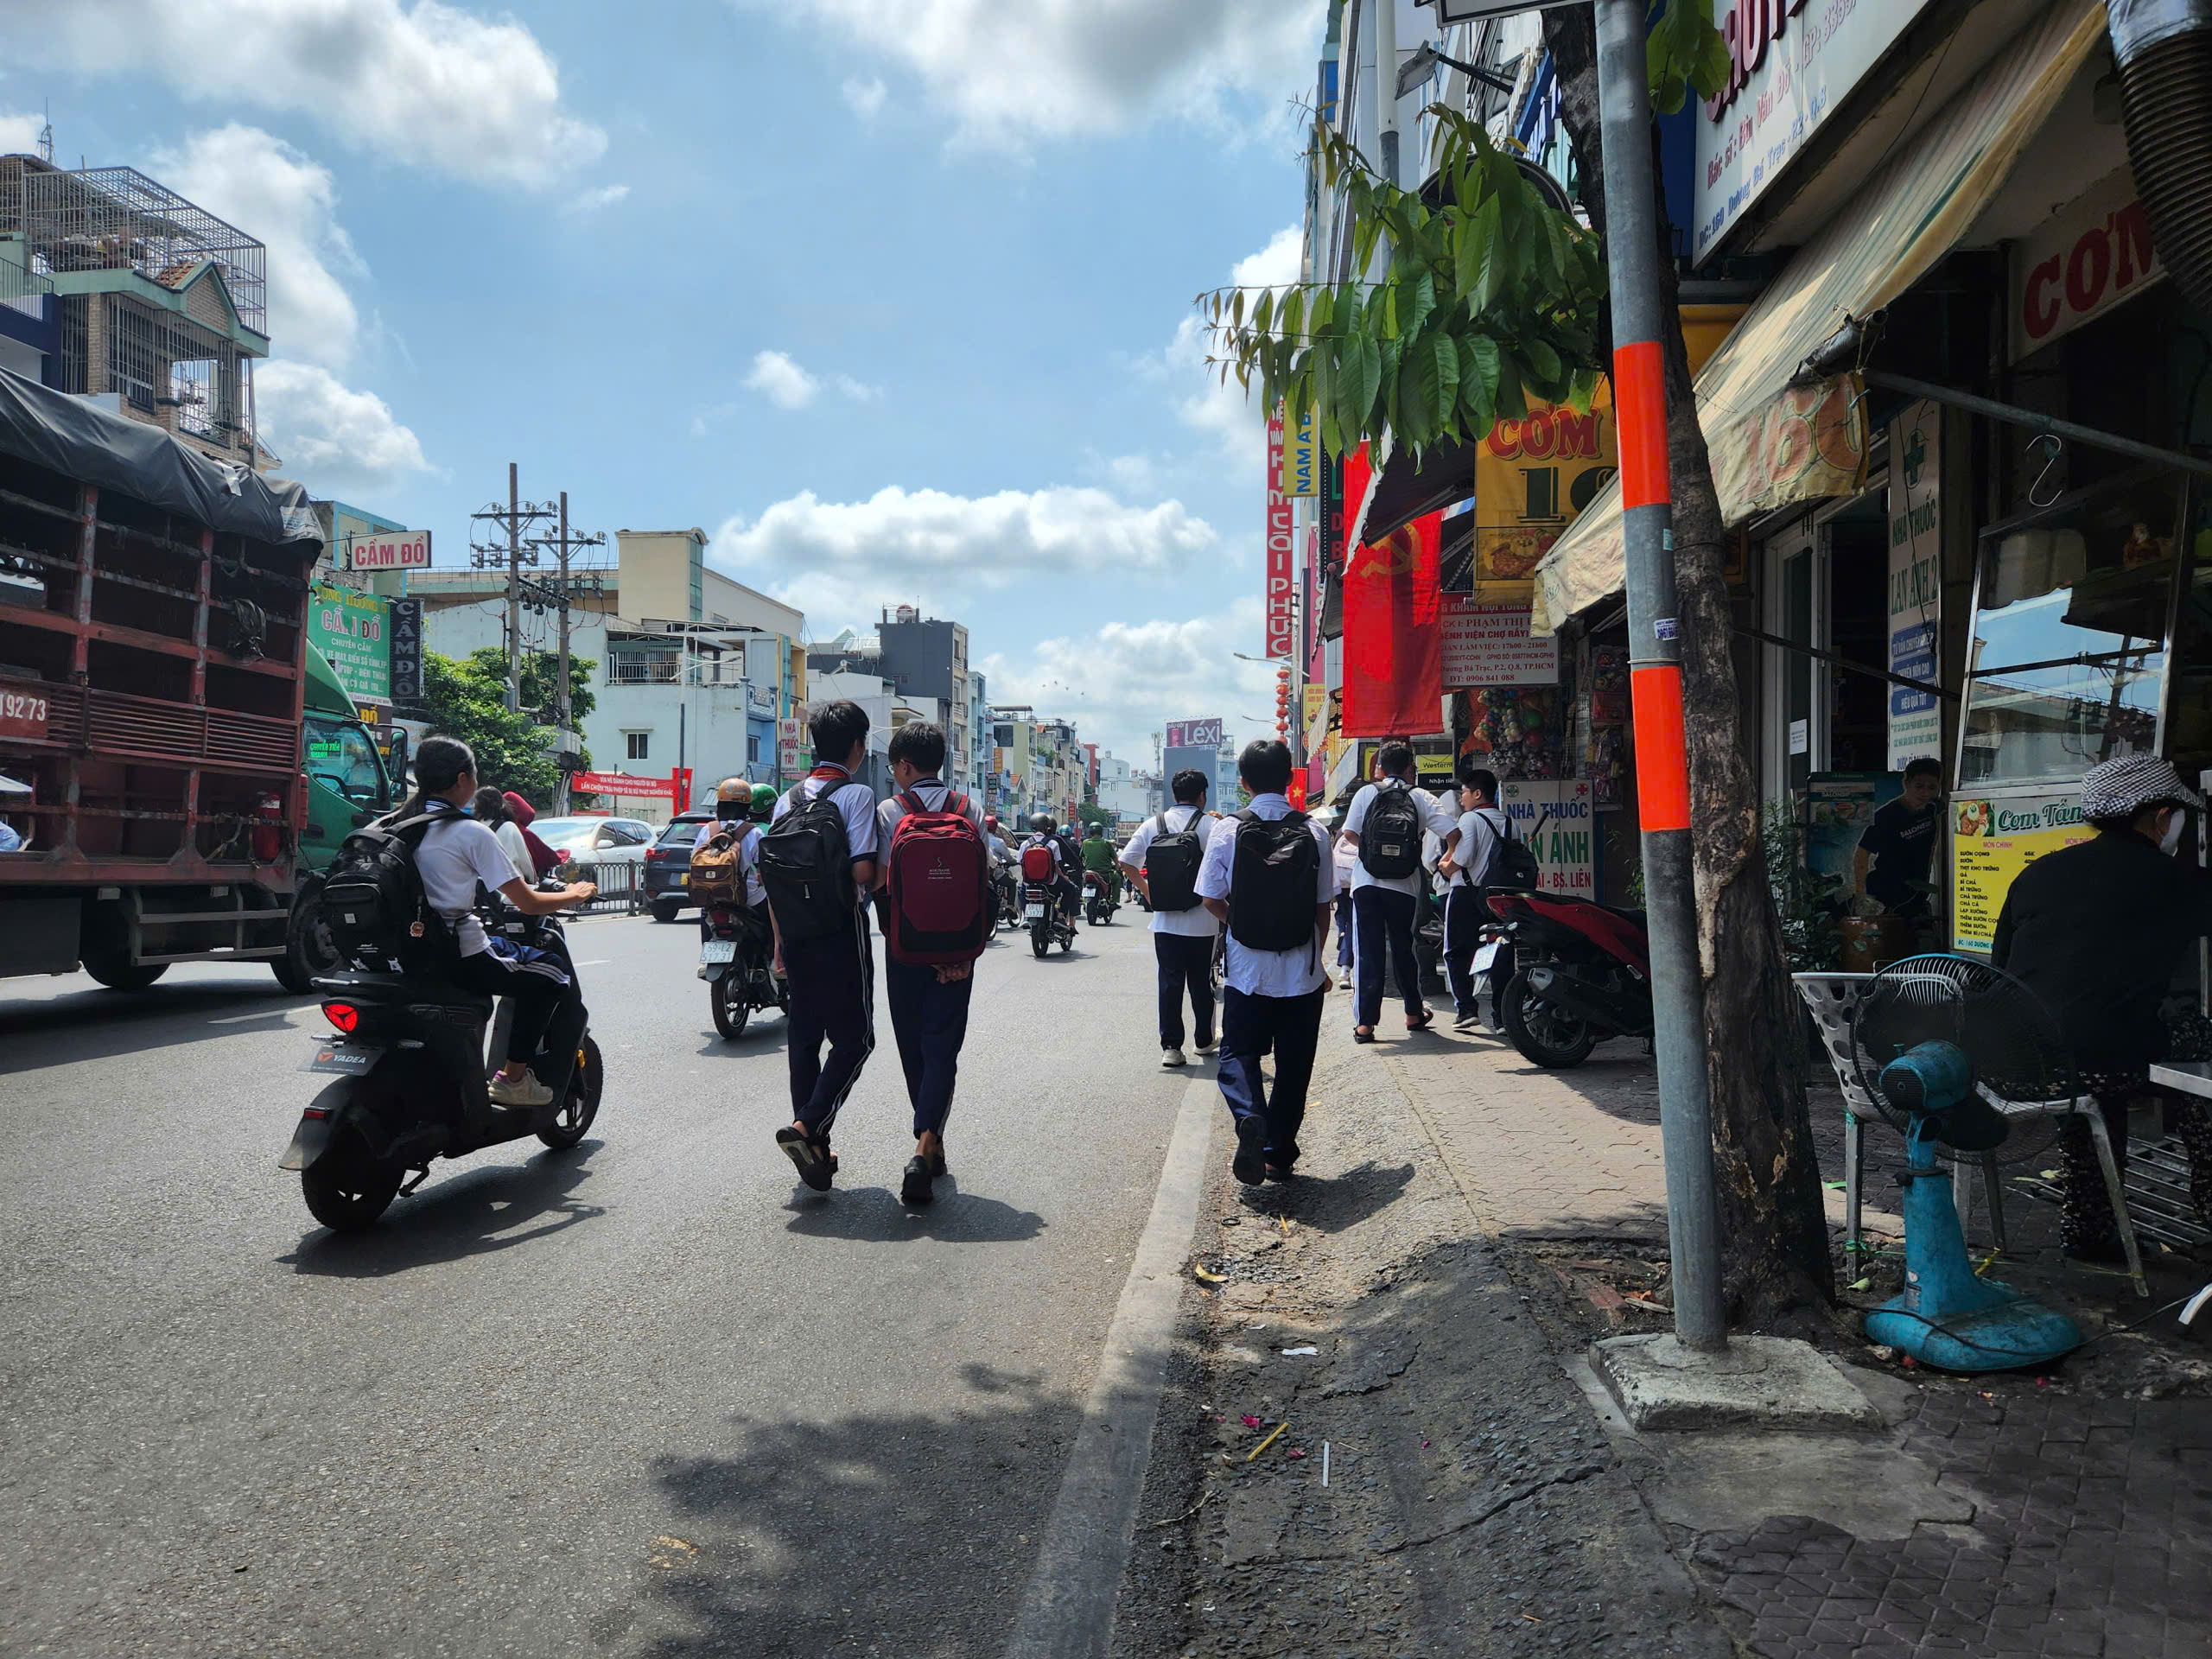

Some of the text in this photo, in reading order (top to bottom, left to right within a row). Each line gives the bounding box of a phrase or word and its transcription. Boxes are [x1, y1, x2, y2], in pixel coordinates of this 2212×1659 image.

[1297, 448, 1312, 493] NAM
[355, 535, 424, 566] CẦM ĐỒ
[1466, 618, 1500, 629] PHẠM
[1503, 617, 1522, 628] THỊ
[1465, 630, 1484, 640] VIỆN
[1487, 630, 1506, 639] CHỢ
[1524, 662, 1554, 671] TP.HCM
[1185, 720, 1220, 745] Léxi
[1506, 796, 1588, 819] NHÀ THUỐC
[1549, 822, 1588, 864] ÁNH
[1571, 868, 1591, 888] LIÊN
[334, 1055, 366, 1064] YADEA
